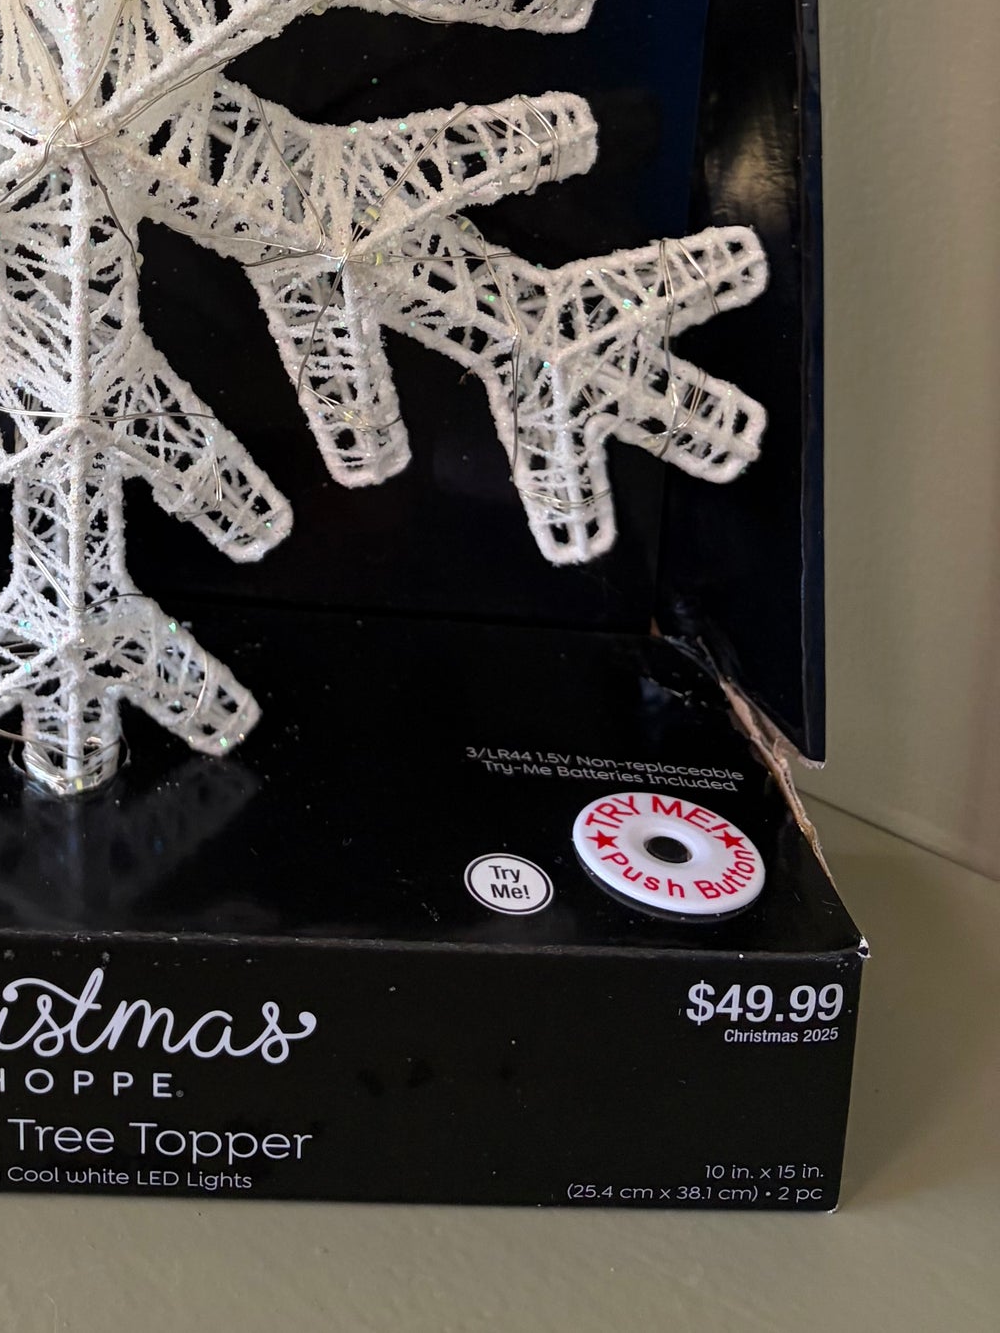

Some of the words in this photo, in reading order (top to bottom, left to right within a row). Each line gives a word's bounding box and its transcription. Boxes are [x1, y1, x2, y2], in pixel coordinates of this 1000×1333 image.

[481, 760, 551, 776] Try-Me
[556, 766, 644, 784] Batteries
[647, 773, 738, 792] Included
[535, 751, 571, 765] 1.5V
[576, 755, 744, 781] Non-replaceable
[585, 795, 641, 829] TRY
[652, 796, 730, 833] ME!
[488, 865, 520, 883] Try
[601, 851, 685, 898] Push
[693, 849, 756, 899] Button
[490, 883, 531, 899] Me!
[686, 979, 844, 1026] $49.99
[724, 1029, 799, 1043] Christmas
[802, 1027, 839, 1042] 2025
[7, 1118, 115, 1154] Tree
[129, 1122, 313, 1166] Topper
[7, 1166, 60, 1183] Cool
[65, 1168, 130, 1185] white
[136, 1170, 180, 1186] LED
[186, 1171, 253, 1191] Lights
[704, 1165, 725, 1179] 10
[731, 1164, 754, 1179] in.
[759, 1167, 771, 1179] x
[777, 1165, 796, 1179] 15
[802, 1164, 824, 1179] in.
[566, 1183, 614, 1199] (25.4
[619, 1186, 654, 1200] cm
[659, 1187, 672, 1200] x
[676, 1186, 712, 1200] 38.1
[717, 1185, 758, 1203] cm)
[778, 1186, 790, 1201] 2
[795, 1186, 823, 1204] pc
